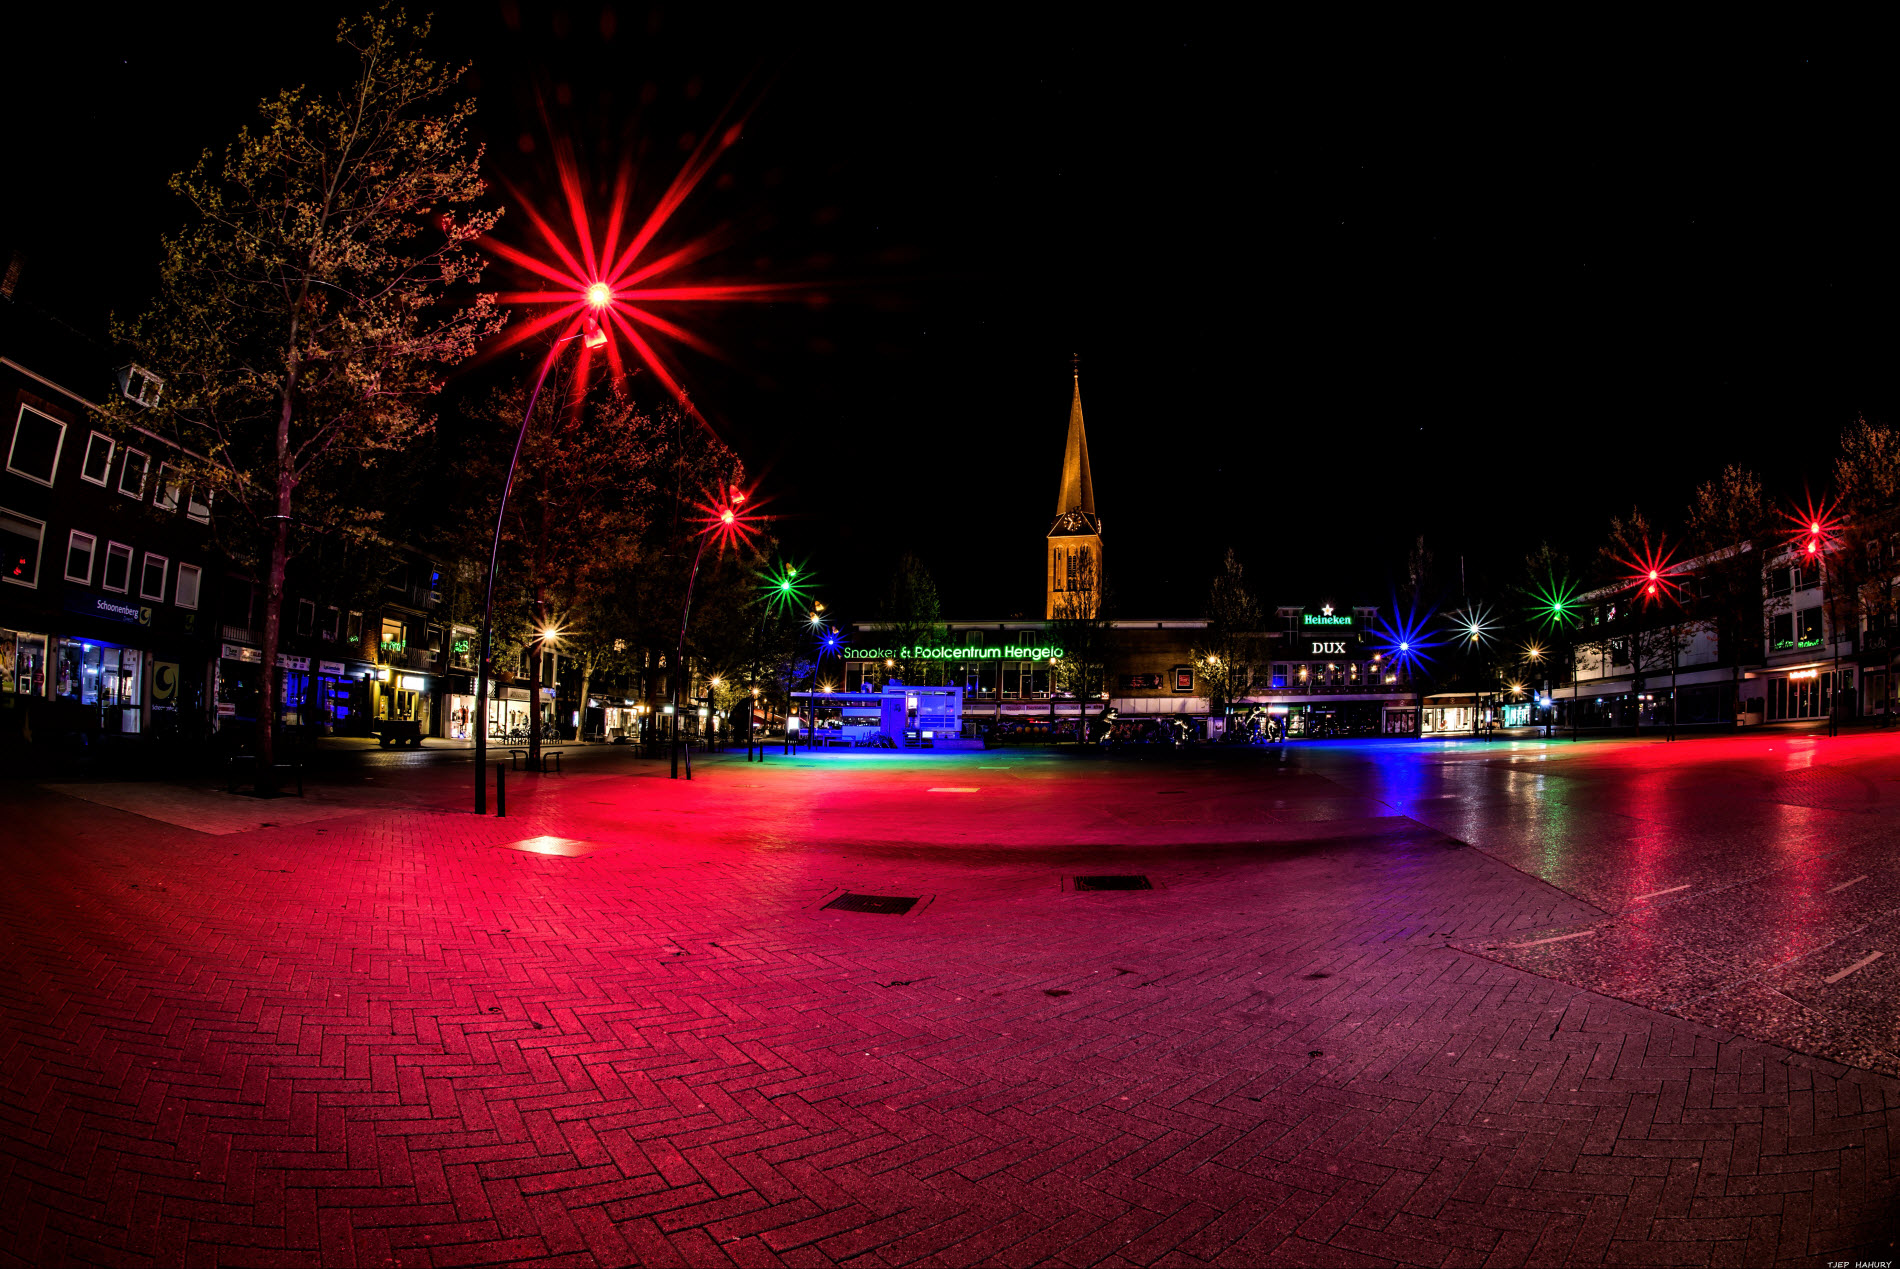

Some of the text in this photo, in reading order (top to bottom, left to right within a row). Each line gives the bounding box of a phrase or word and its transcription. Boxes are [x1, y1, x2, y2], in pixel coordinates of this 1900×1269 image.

[97, 599, 139, 619] Schoonenberg
[1304, 614, 1352, 625] Heineken
[843, 645, 1064, 661] Snooker & Poolcentrum Hengelo
[1312, 642, 1346, 654] DUX
